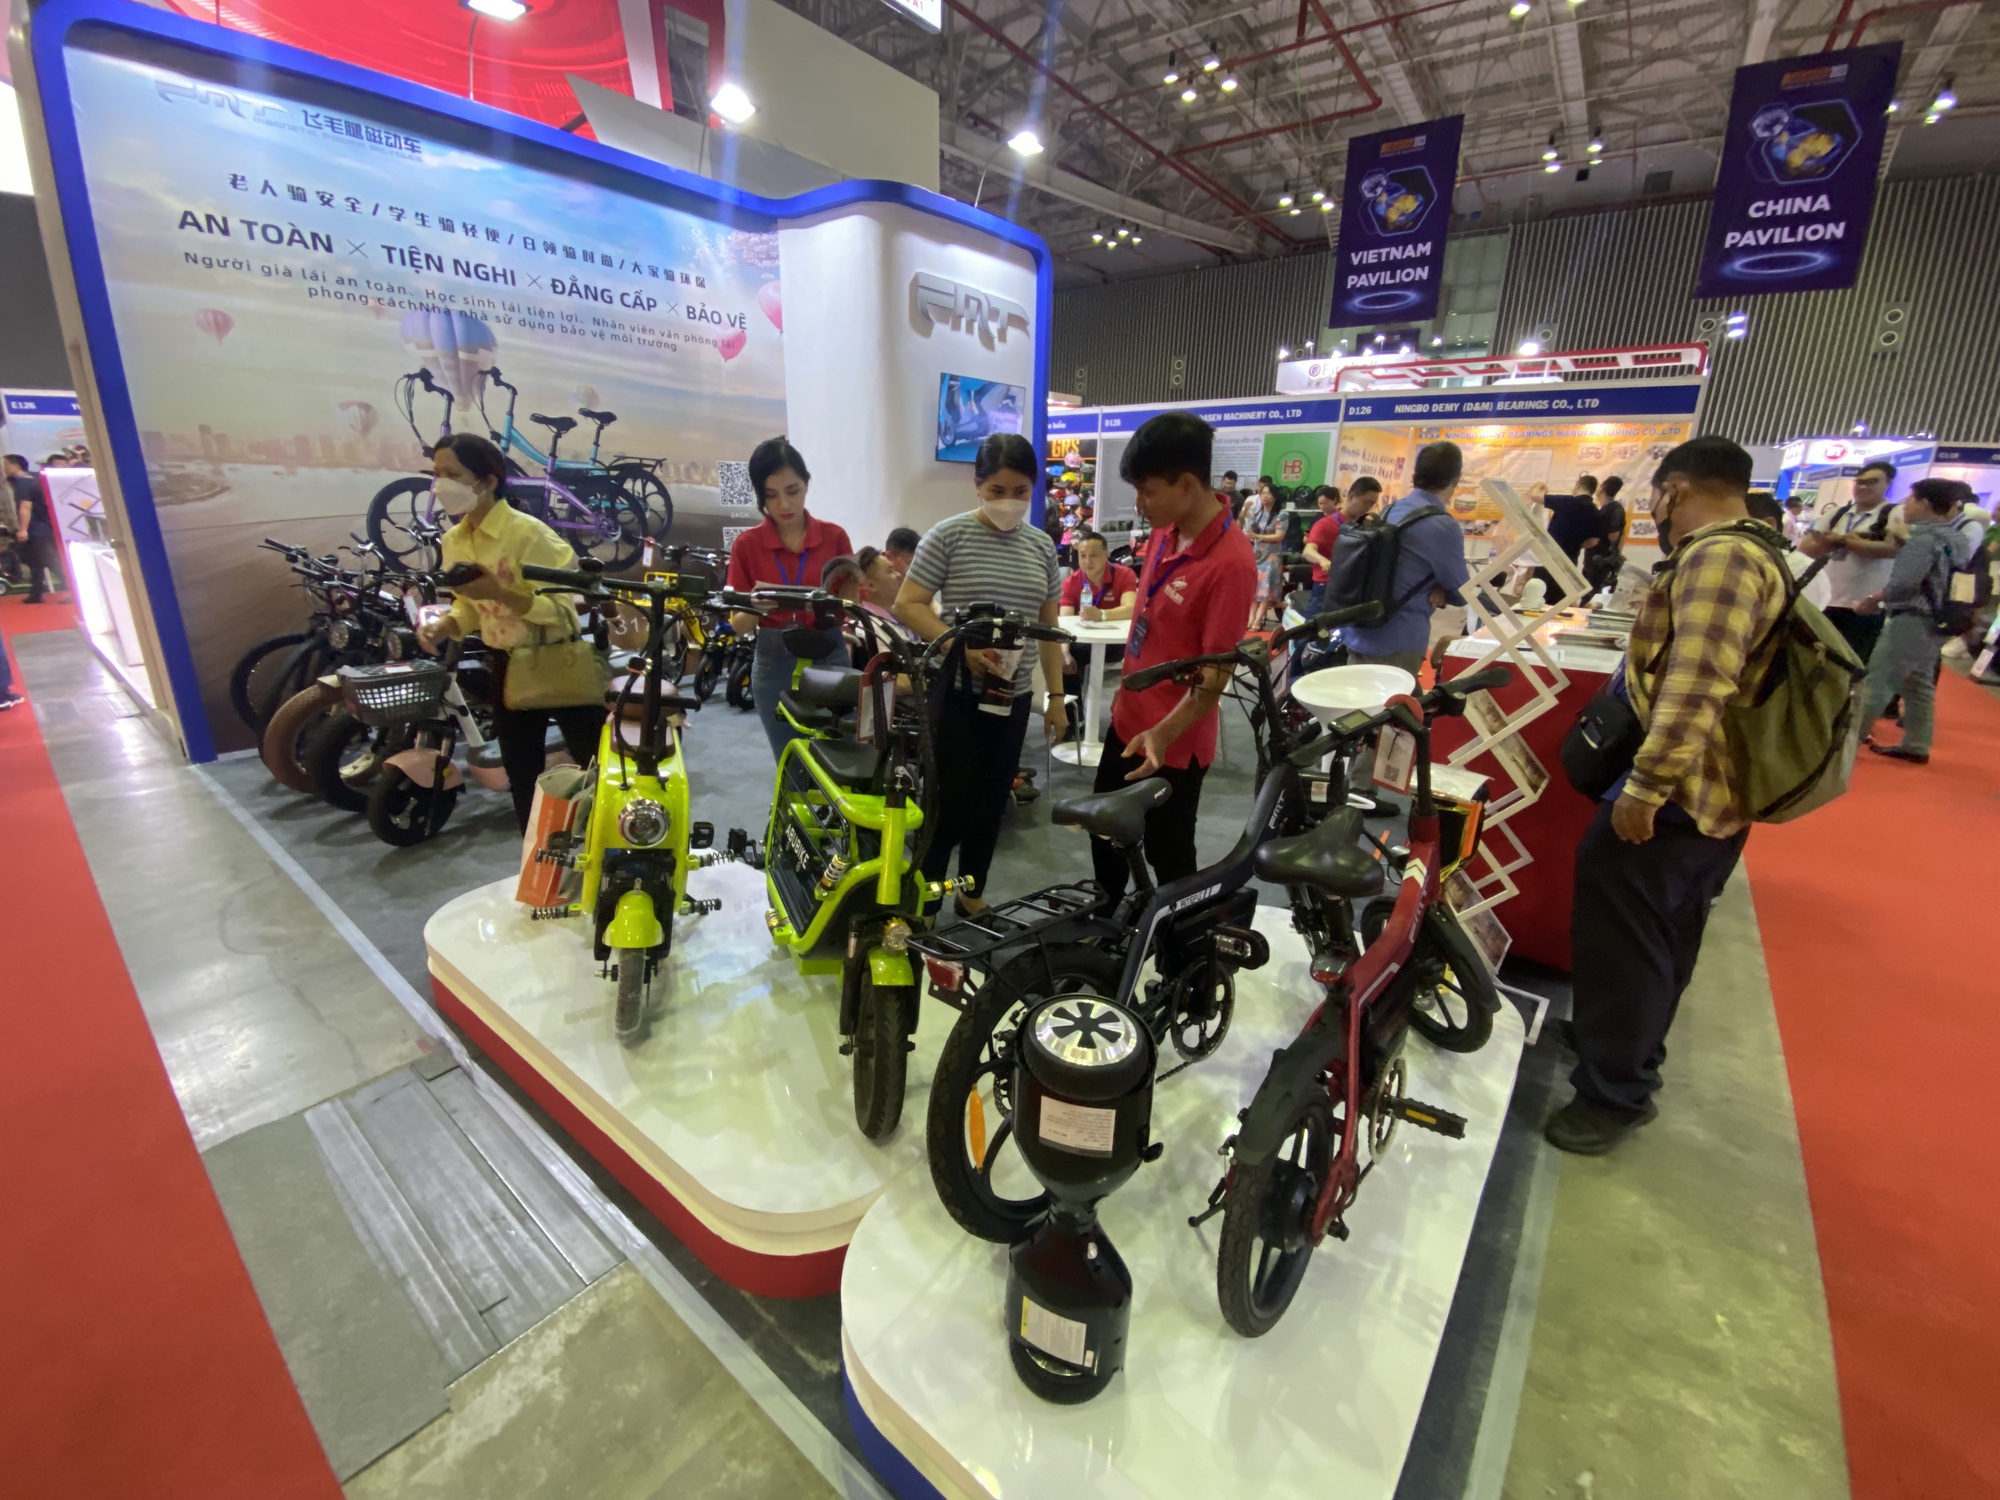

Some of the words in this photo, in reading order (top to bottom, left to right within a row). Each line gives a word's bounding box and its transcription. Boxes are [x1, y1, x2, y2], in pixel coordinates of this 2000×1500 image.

[1748, 194, 1831, 219] CHINA
[1724, 221, 1847, 249] PAVILION
[1350, 241, 1432, 266] VIETNAM
[178, 210, 231, 237] AN
[239, 219, 334, 254] TOÀN
[380, 244, 445, 274] TIỆN
[452, 258, 517, 287] NGHI
[551, 274, 614, 305] ĐẲNG
[620, 289, 657, 312] CẤP
[686, 302, 722, 325] BẢO
[727, 312, 747, 333] VỆ
[1347, 266, 1430, 289] PAVILION
[184, 251, 251, 272] Người
[261, 264, 293, 278] già
[302, 268, 326, 283] lái
[336, 275, 358, 288] an
[425, 289, 456, 304] Học
[463, 295, 496, 310] sinh
[502, 301, 521, 314] lái
[527, 306, 555, 321] tiện
[592, 316, 625, 331] Nhân
[630, 322, 655, 335] viên
[308, 285, 370, 306] phong
[459, 306, 488, 322] nhà
[518, 314, 555, 334] dụng
[560, 321, 586, 337] bảo
[591, 326, 606, 341] vệ
[611, 331, 633, 344] môi
[638, 337, 677, 352] trường
[1223, 411, 1267, 421] MACHINERY
[1268, 410, 1284, 420] CO.,
[1286, 408, 1303, 418] LTD
[1349, 405, 1373, 416] D126
[1394, 404, 1430, 414] NINGBO
[1432, 402, 1460, 412] DEMY
[1463, 401, 1493, 412] (D&M)
[1496, 399, 1549, 411] BEARINGS
[1552, 399, 1574, 410] CO.,
[1577, 398, 1600, 409] LTD
[1508, 429, 1553, 438] BEARINGS
